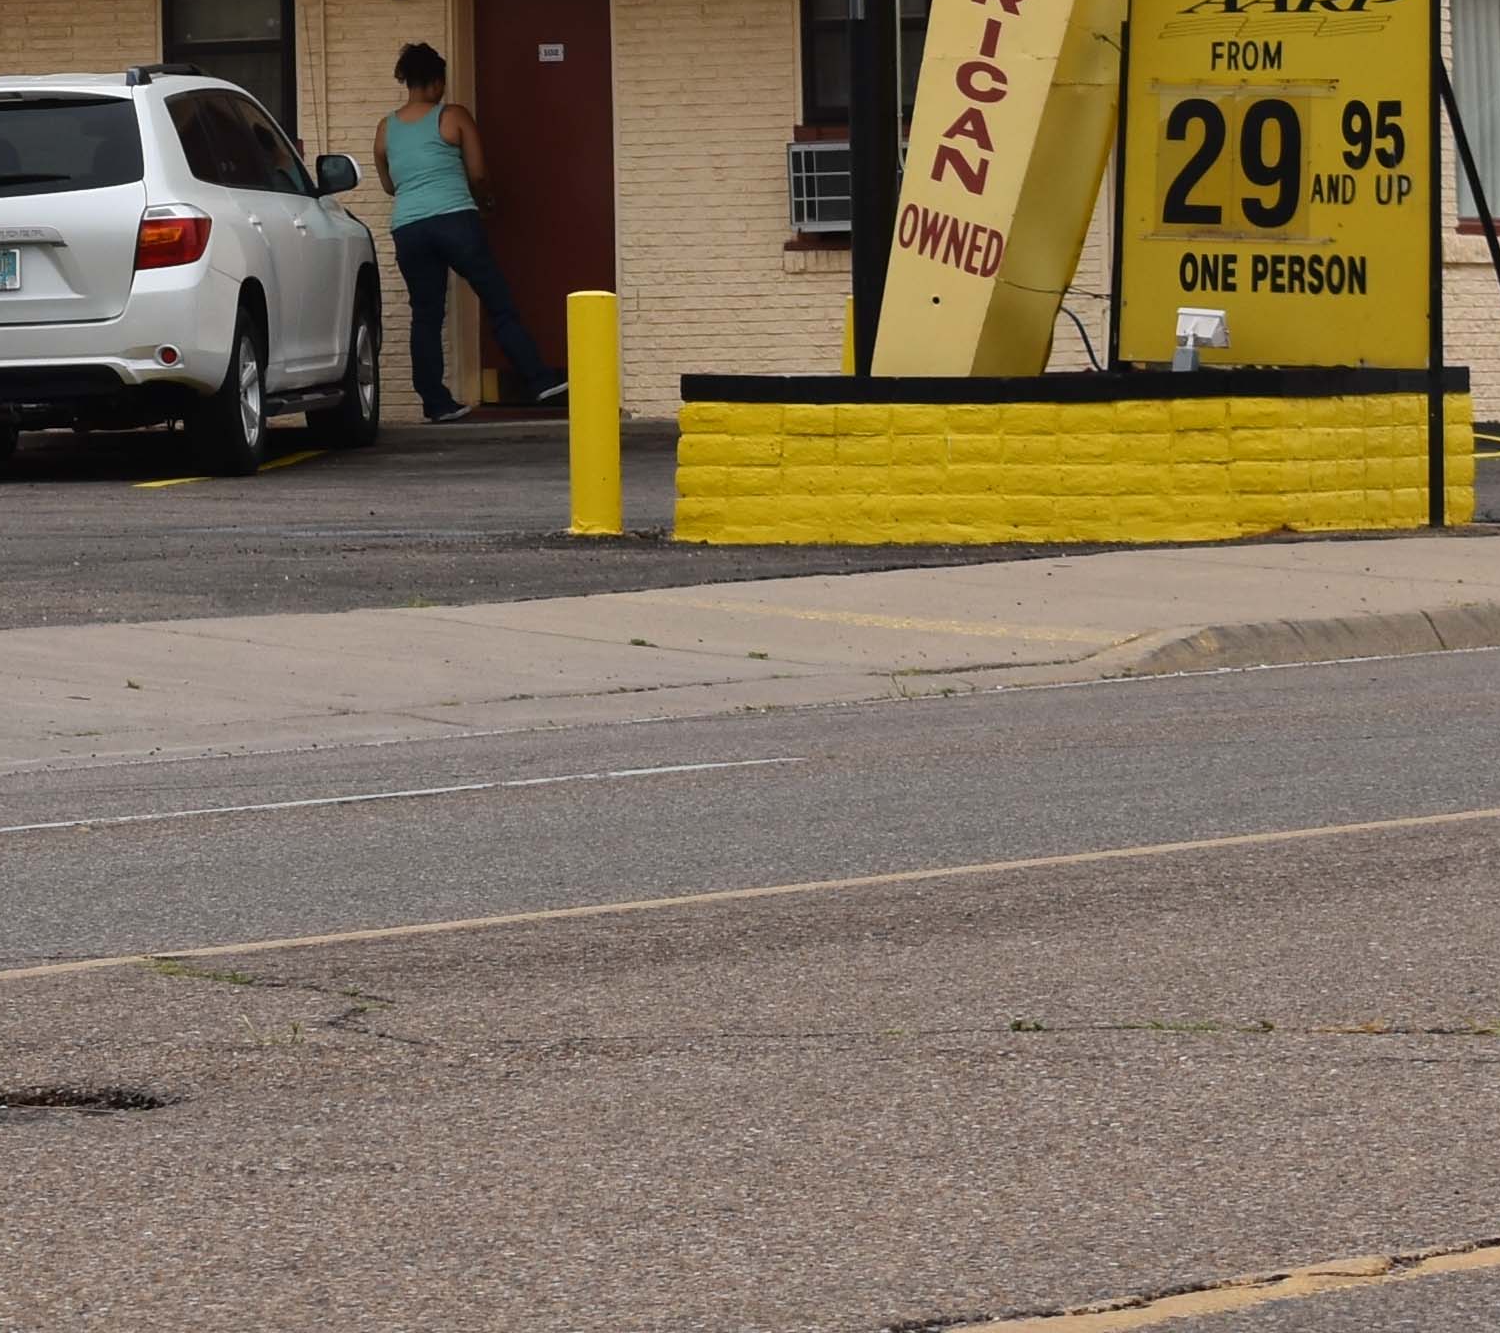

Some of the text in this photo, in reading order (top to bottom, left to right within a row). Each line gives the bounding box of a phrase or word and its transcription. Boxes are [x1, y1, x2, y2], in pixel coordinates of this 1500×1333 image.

[1210, 40, 1284, 72] FROM
[1161, 97, 1405, 228] 29 95
[1310, 173, 1413, 206] AND UP
[897, 203, 1005, 278] OWNED
[1178, 251, 1368, 295] ONE PERSON
